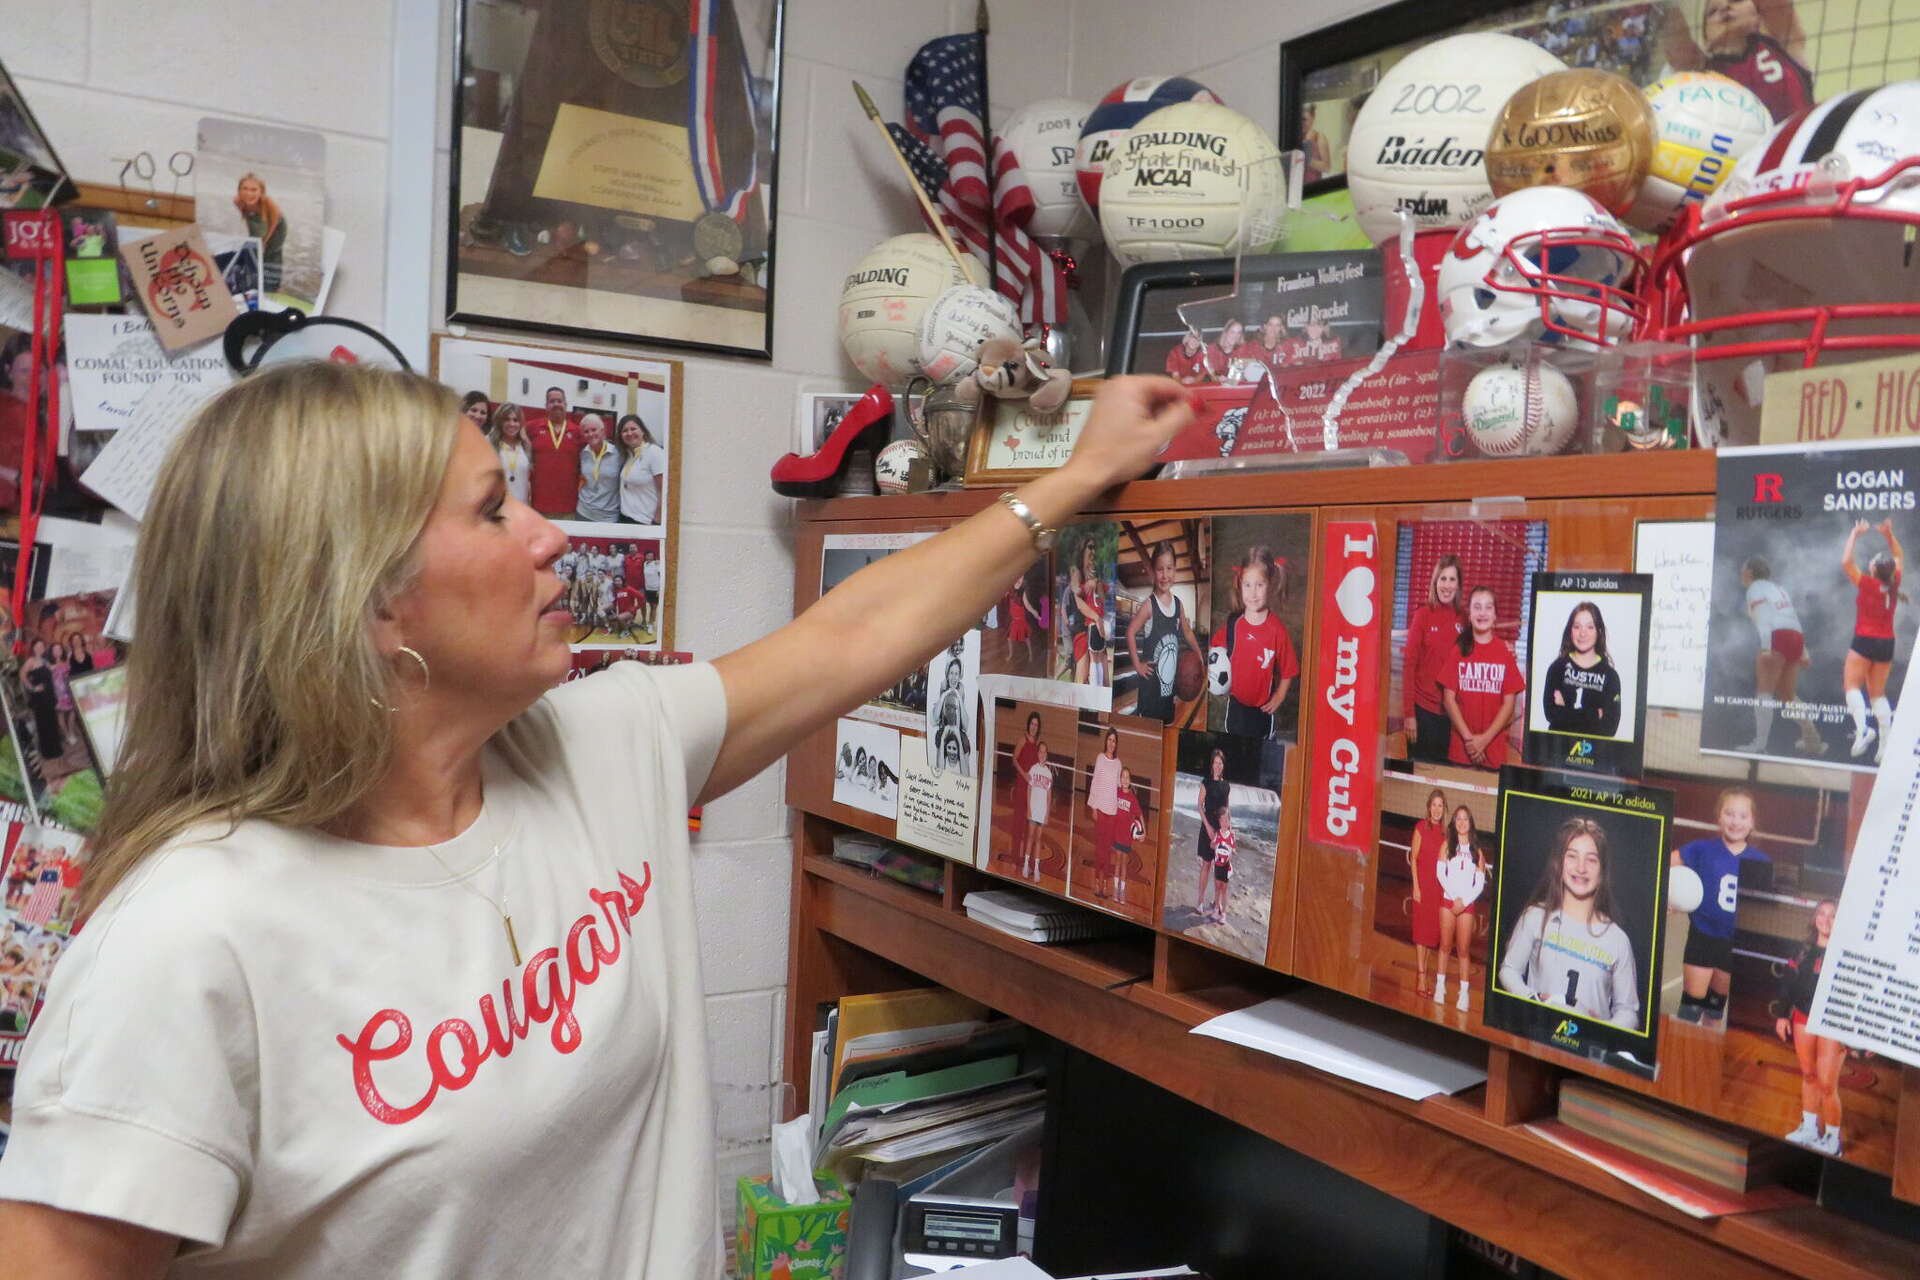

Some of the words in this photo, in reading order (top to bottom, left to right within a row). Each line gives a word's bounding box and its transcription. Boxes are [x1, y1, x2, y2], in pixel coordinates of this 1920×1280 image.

[1391, 84, 1486, 115] 2002
[1125, 132, 1228, 157] SPALDING
[1519, 122, 1564, 148] 600
[1567, 121, 1618, 144] Wins
[1124, 151, 1174, 172] State
[1134, 169, 1192, 187] NCAA
[1318, 262, 1364, 284] Volleyfest
[1287, 305, 1310, 328] Gold
[1310, 300, 1349, 323] Bracket
[74, 358, 128, 370] COMAL
[138, 356, 224, 370] EDUCATION
[1299, 383, 1327, 400] 2022
[1396, 396, 1410, 406] to
[1356, 411, 1408, 425] creativity
[1798, 378, 1849, 442] RED
[1046, 427, 1071, 444] and
[1372, 429, 1384, 440] in
[1007, 445, 1046, 467] proud
[1047, 444, 1060, 466] of
[1753, 472, 1785, 504] R
[1836, 469, 1905, 490] LOGAN
[1823, 491, 1917, 512] SANDERS
[1735, 505, 1803, 521] RUTGERS
[1342, 533, 1375, 559] I
[1560, 578, 1574, 589] AP
[1575, 578, 1587, 590] 13
[1589, 578, 1619, 590] adidas
[1326, 635, 1359, 726] my
[1458, 661, 1506, 681] CANYON
[1564, 668, 1606, 685] AUSTIN
[1458, 679, 1503, 695] VOLLEYBALL
[1573, 687, 1584, 710] 1
[1727, 696, 1760, 707] CANYON
[1761, 698, 1783, 709] HIGH
[1780, 709, 1807, 721] CLASS
[1808, 712, 1820, 721] OF
[1822, 713, 1846, 724] 2027
[1566, 755, 1595, 766] AUSTIN
[1326, 737, 1360, 837] Cub
[1570, 786, 1593, 800] 2021
[1595, 790, 1609, 802] AP
[1611, 793, 1624, 805] 12
[1624, 795, 1656, 811] adidas
[1842, 949, 1871, 964] District
[1871, 957, 1897, 971] Match
[335, 860, 652, 1125] Cougars
[1564, 968, 1580, 1008] 1
[1887, 975, 1919, 991] Heather
[1551, 1033, 1581, 1048] AUSTIN
